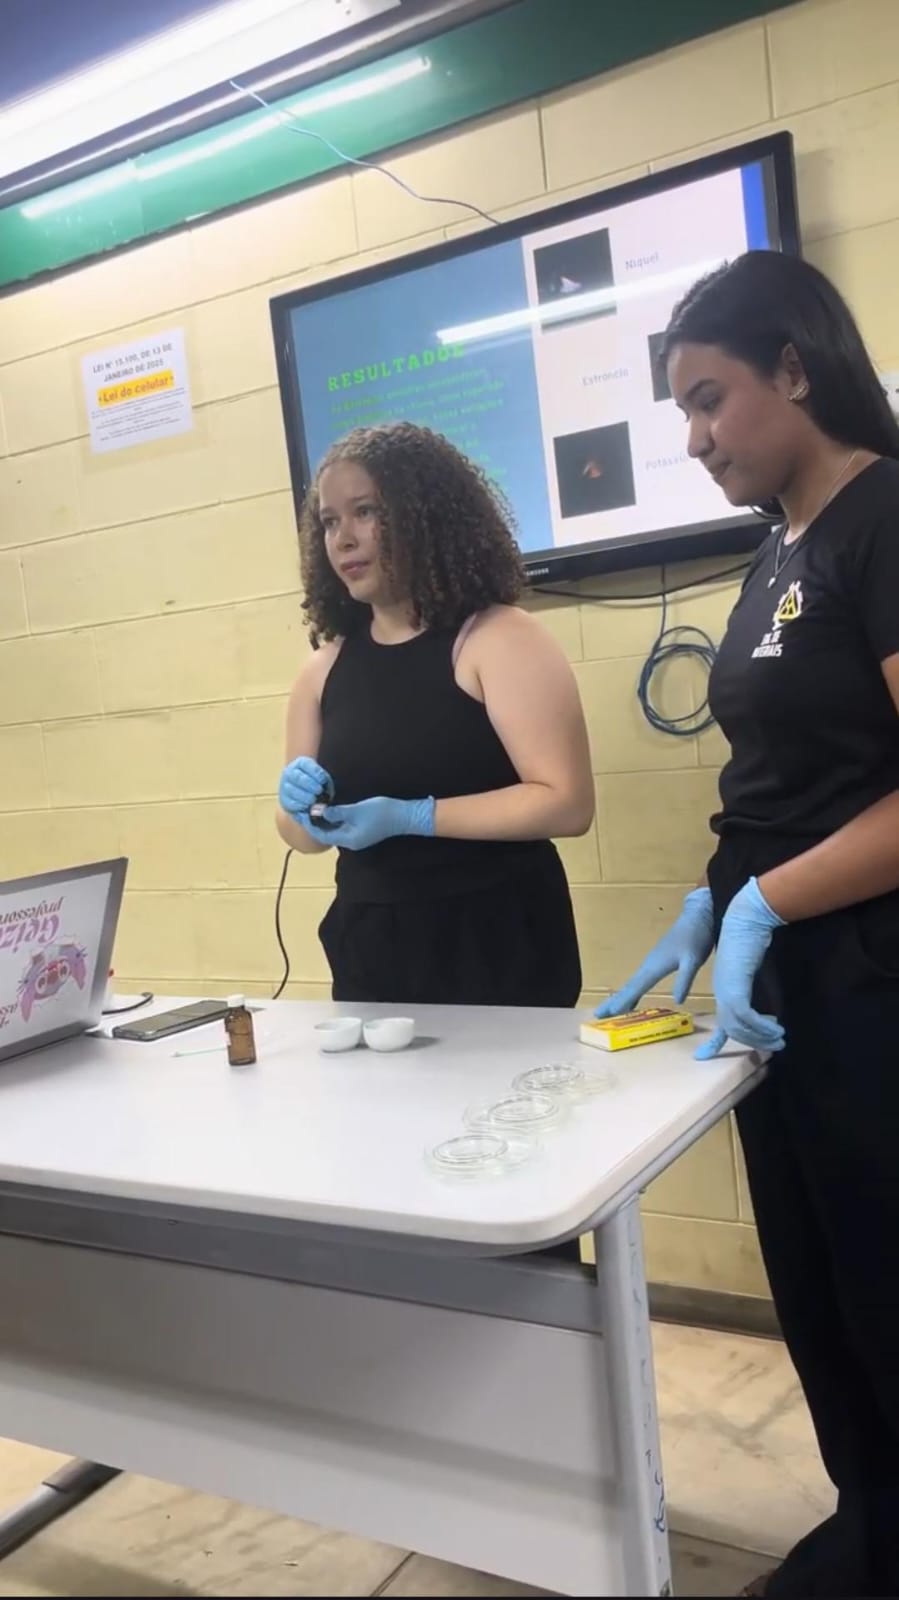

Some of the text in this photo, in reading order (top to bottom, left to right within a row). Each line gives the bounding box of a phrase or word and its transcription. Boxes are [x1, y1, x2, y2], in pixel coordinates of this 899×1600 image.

[93, 365, 104, 374] LEI
[140, 349, 151, 359] DE
[162, 343, 172, 352] DE
[104, 358, 165, 382] JANEIRO DE 2025
[103, 377, 169, 403] Lei do celular
[0, 914, 60, 953] Geiz
